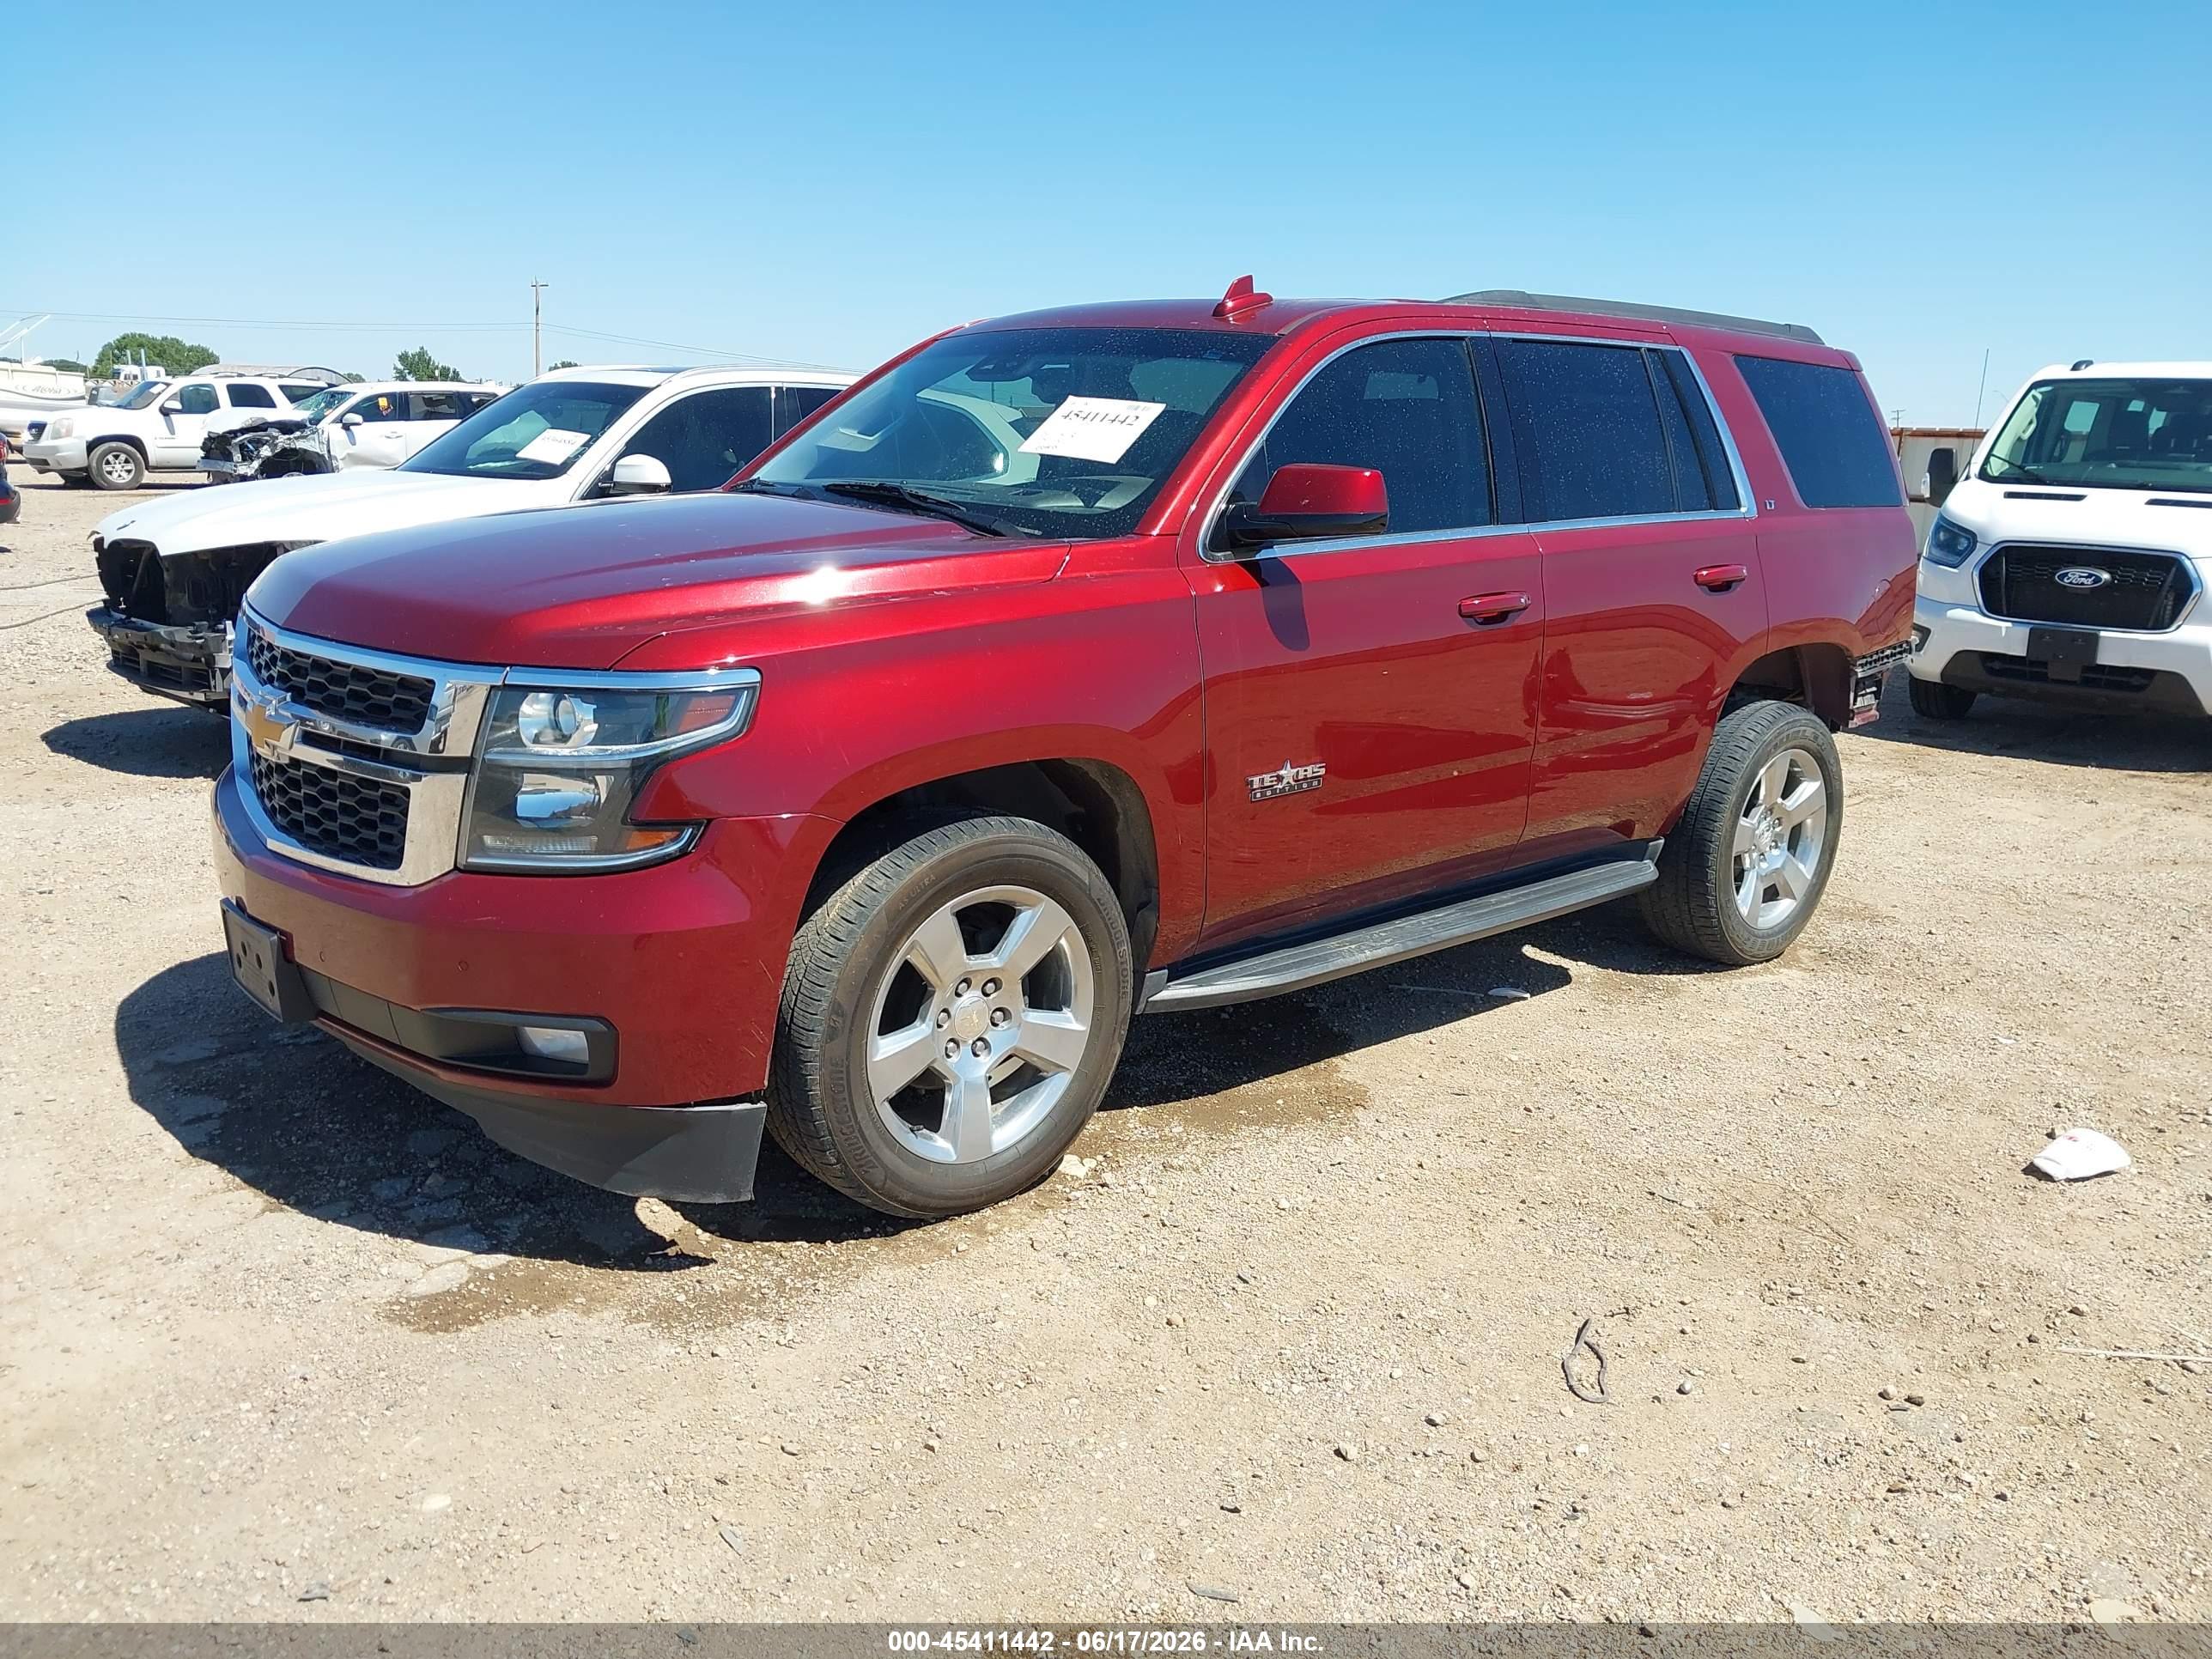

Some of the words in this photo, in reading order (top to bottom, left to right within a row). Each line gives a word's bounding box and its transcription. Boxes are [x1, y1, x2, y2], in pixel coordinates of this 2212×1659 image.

[1060, 409, 1140, 427] 45411442
[2063, 571, 2094, 586] Ford
[1246, 759, 1327, 789] TEXAS
[1255, 781, 1319, 799] EDITION
